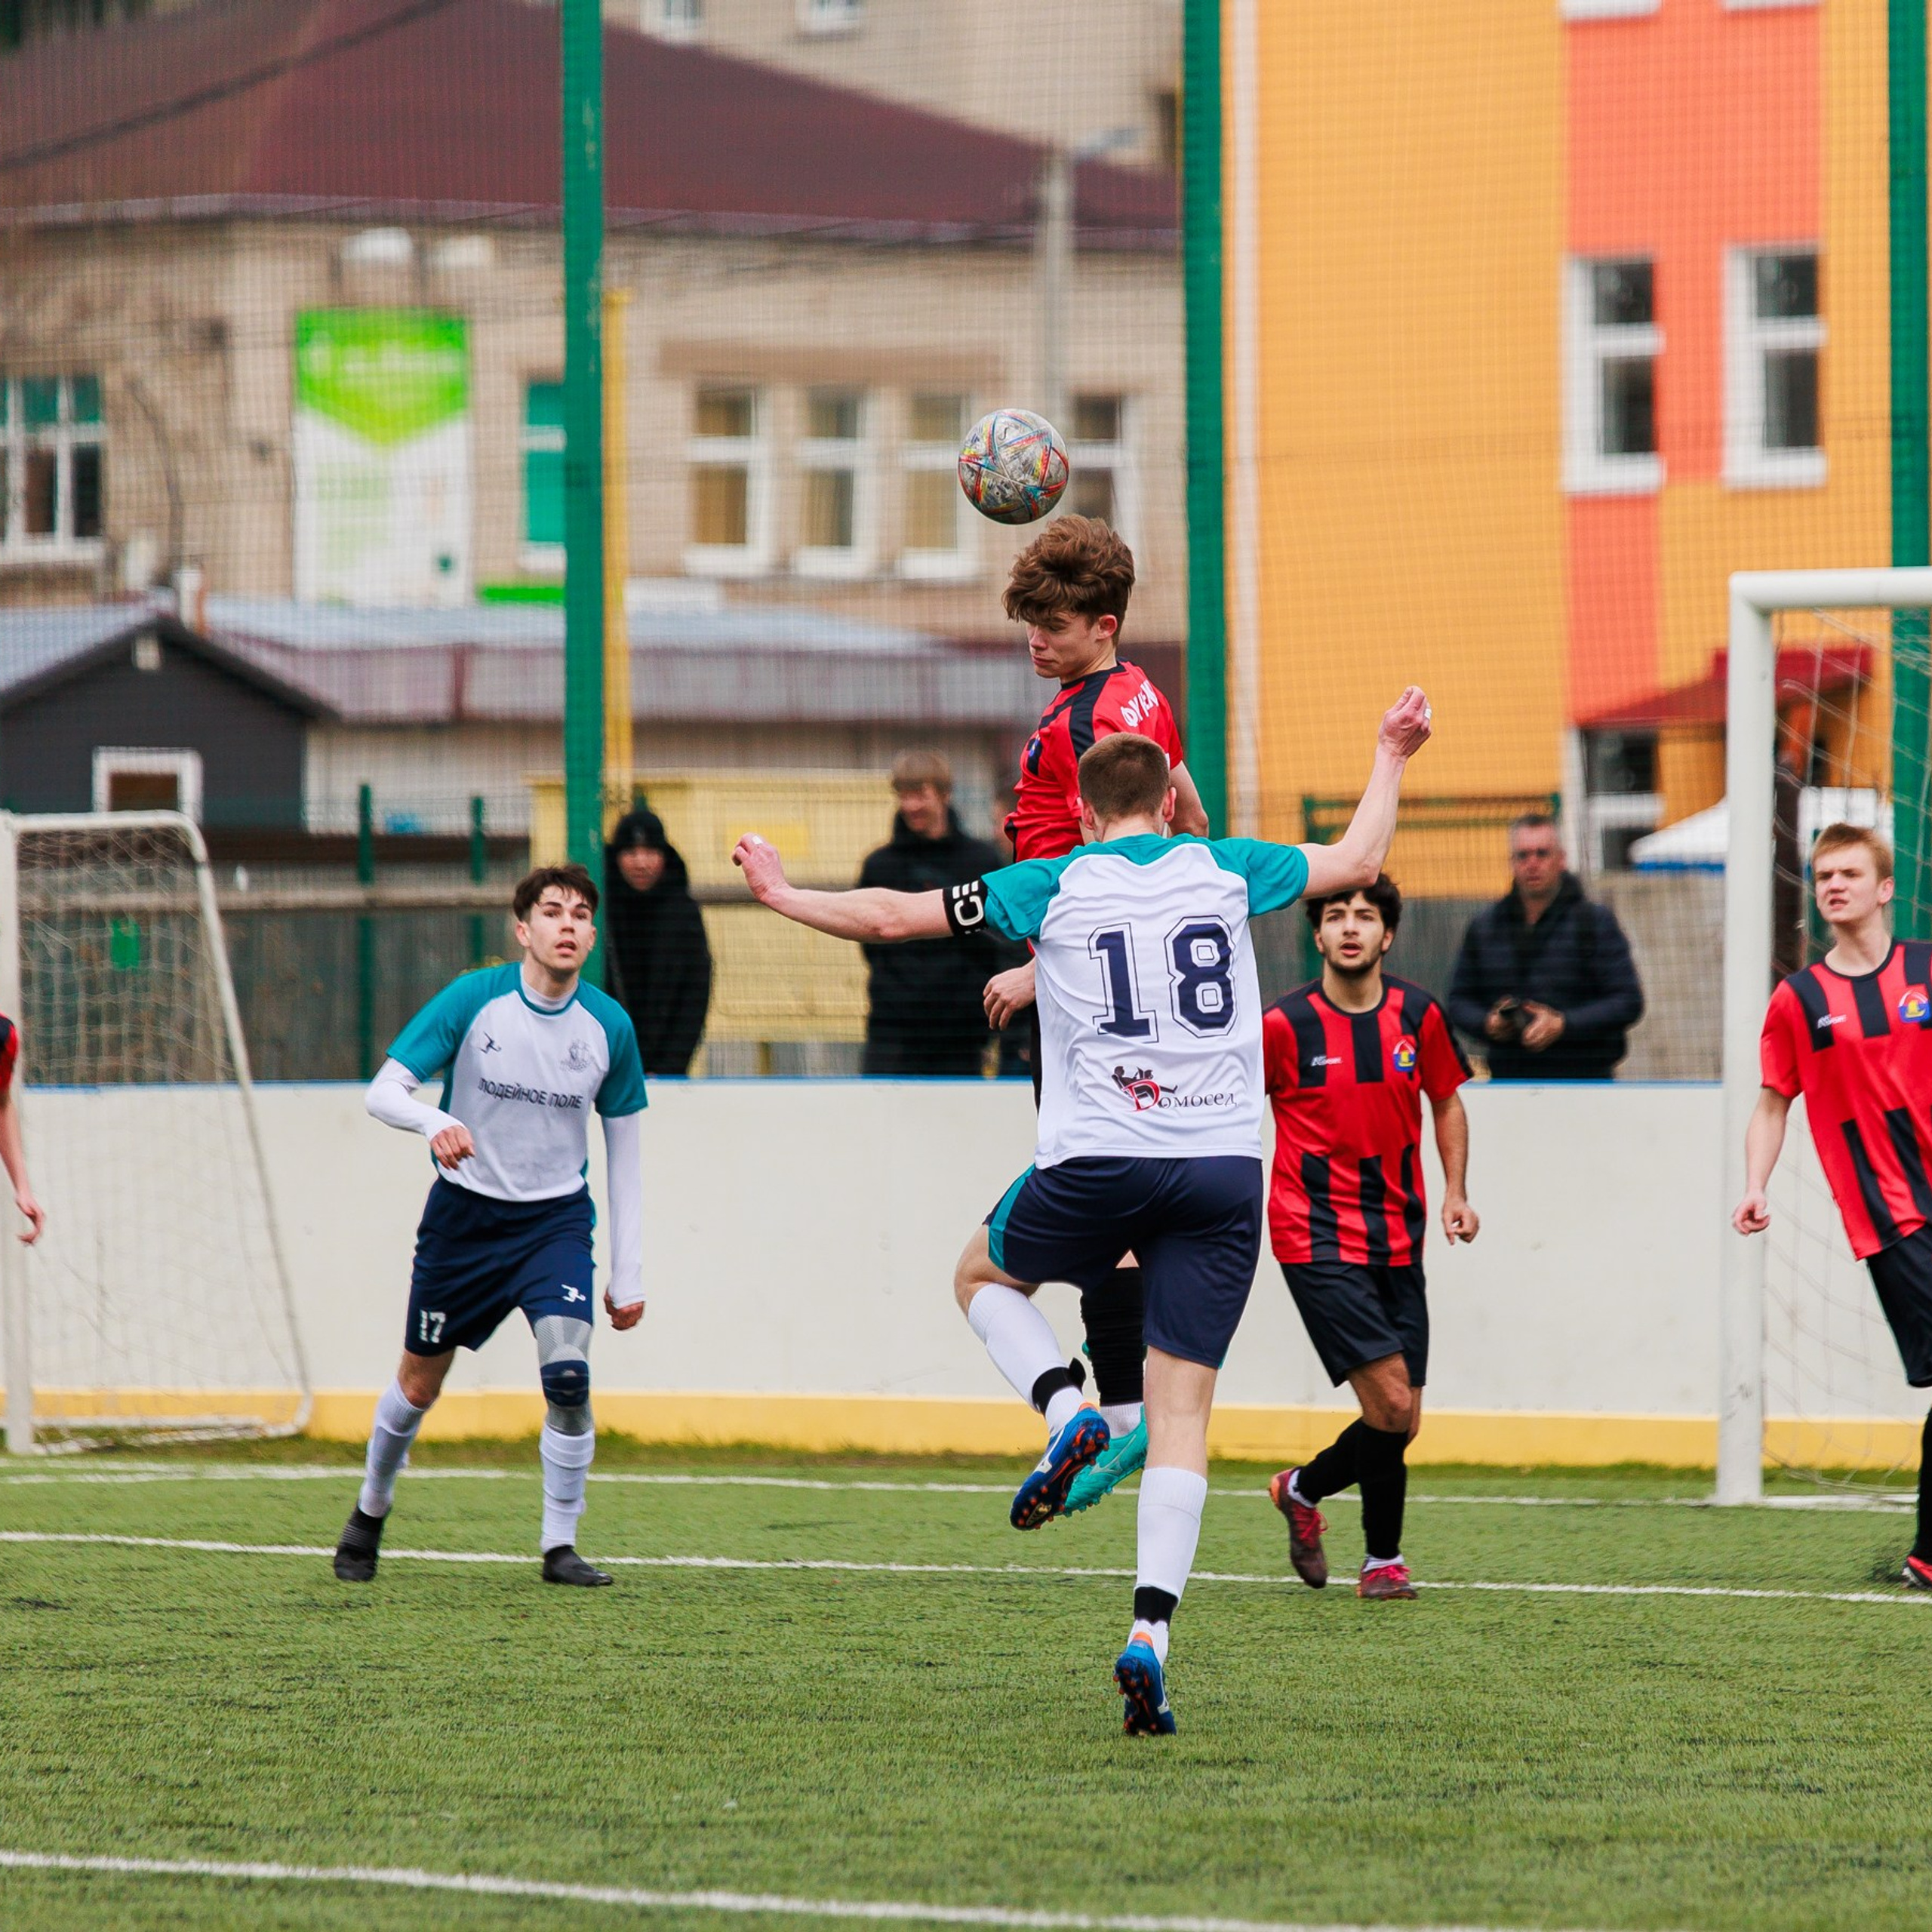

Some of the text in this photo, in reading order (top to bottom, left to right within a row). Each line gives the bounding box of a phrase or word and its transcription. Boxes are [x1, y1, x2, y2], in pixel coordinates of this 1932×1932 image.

[1088, 915, 1238, 1044] 18
[478, 1077, 583, 1109] ЛОДЕЙНОЕ ПОЛЕ
[420, 1309, 446, 1343] 17
